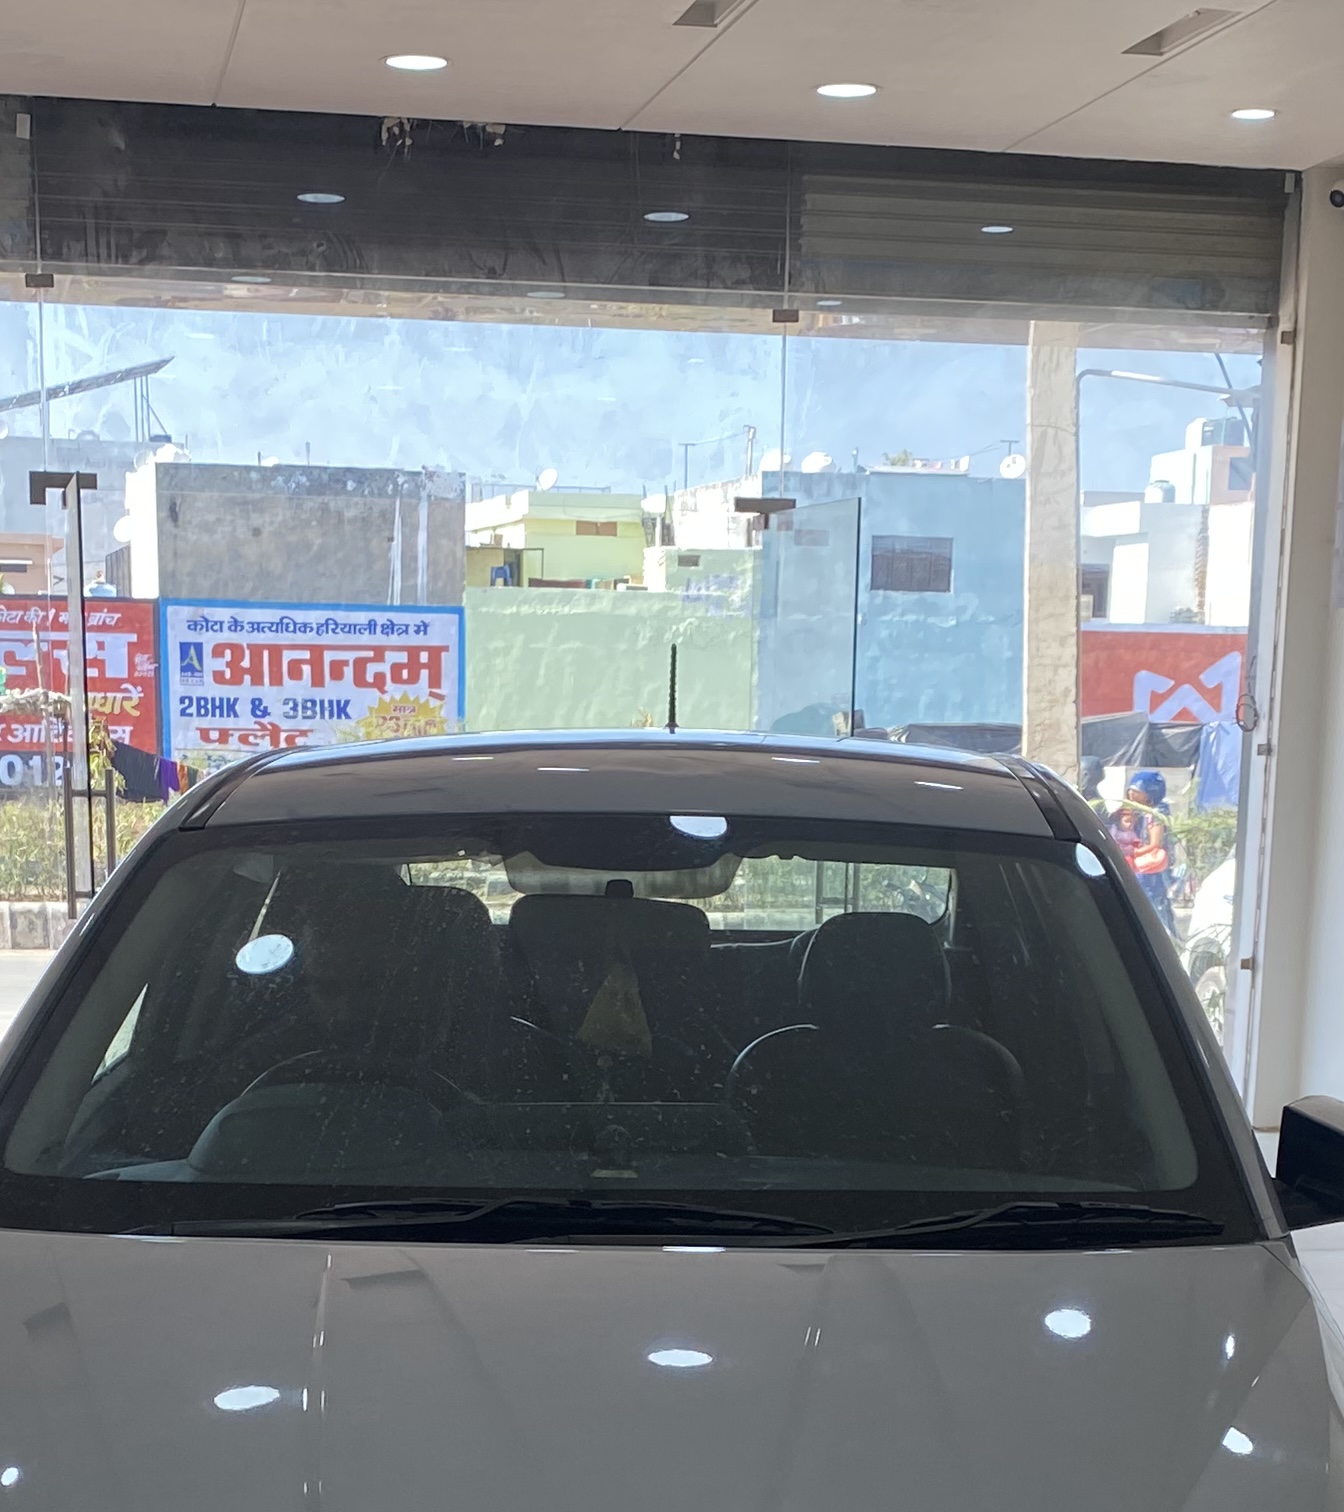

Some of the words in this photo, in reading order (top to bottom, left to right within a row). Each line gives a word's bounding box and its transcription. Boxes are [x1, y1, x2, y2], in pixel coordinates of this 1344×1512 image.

[186, 615, 225, 633] कोटा
[227, 615, 245, 633] के
[246, 616, 314, 635] अत्यधिक
[315, 618, 378, 637] हरियाली
[380, 618, 410, 637] क्षेत्र
[178, 695, 240, 718] 2BHK
[250, 697, 271, 719] &
[282, 697, 352, 720] 3BHK
